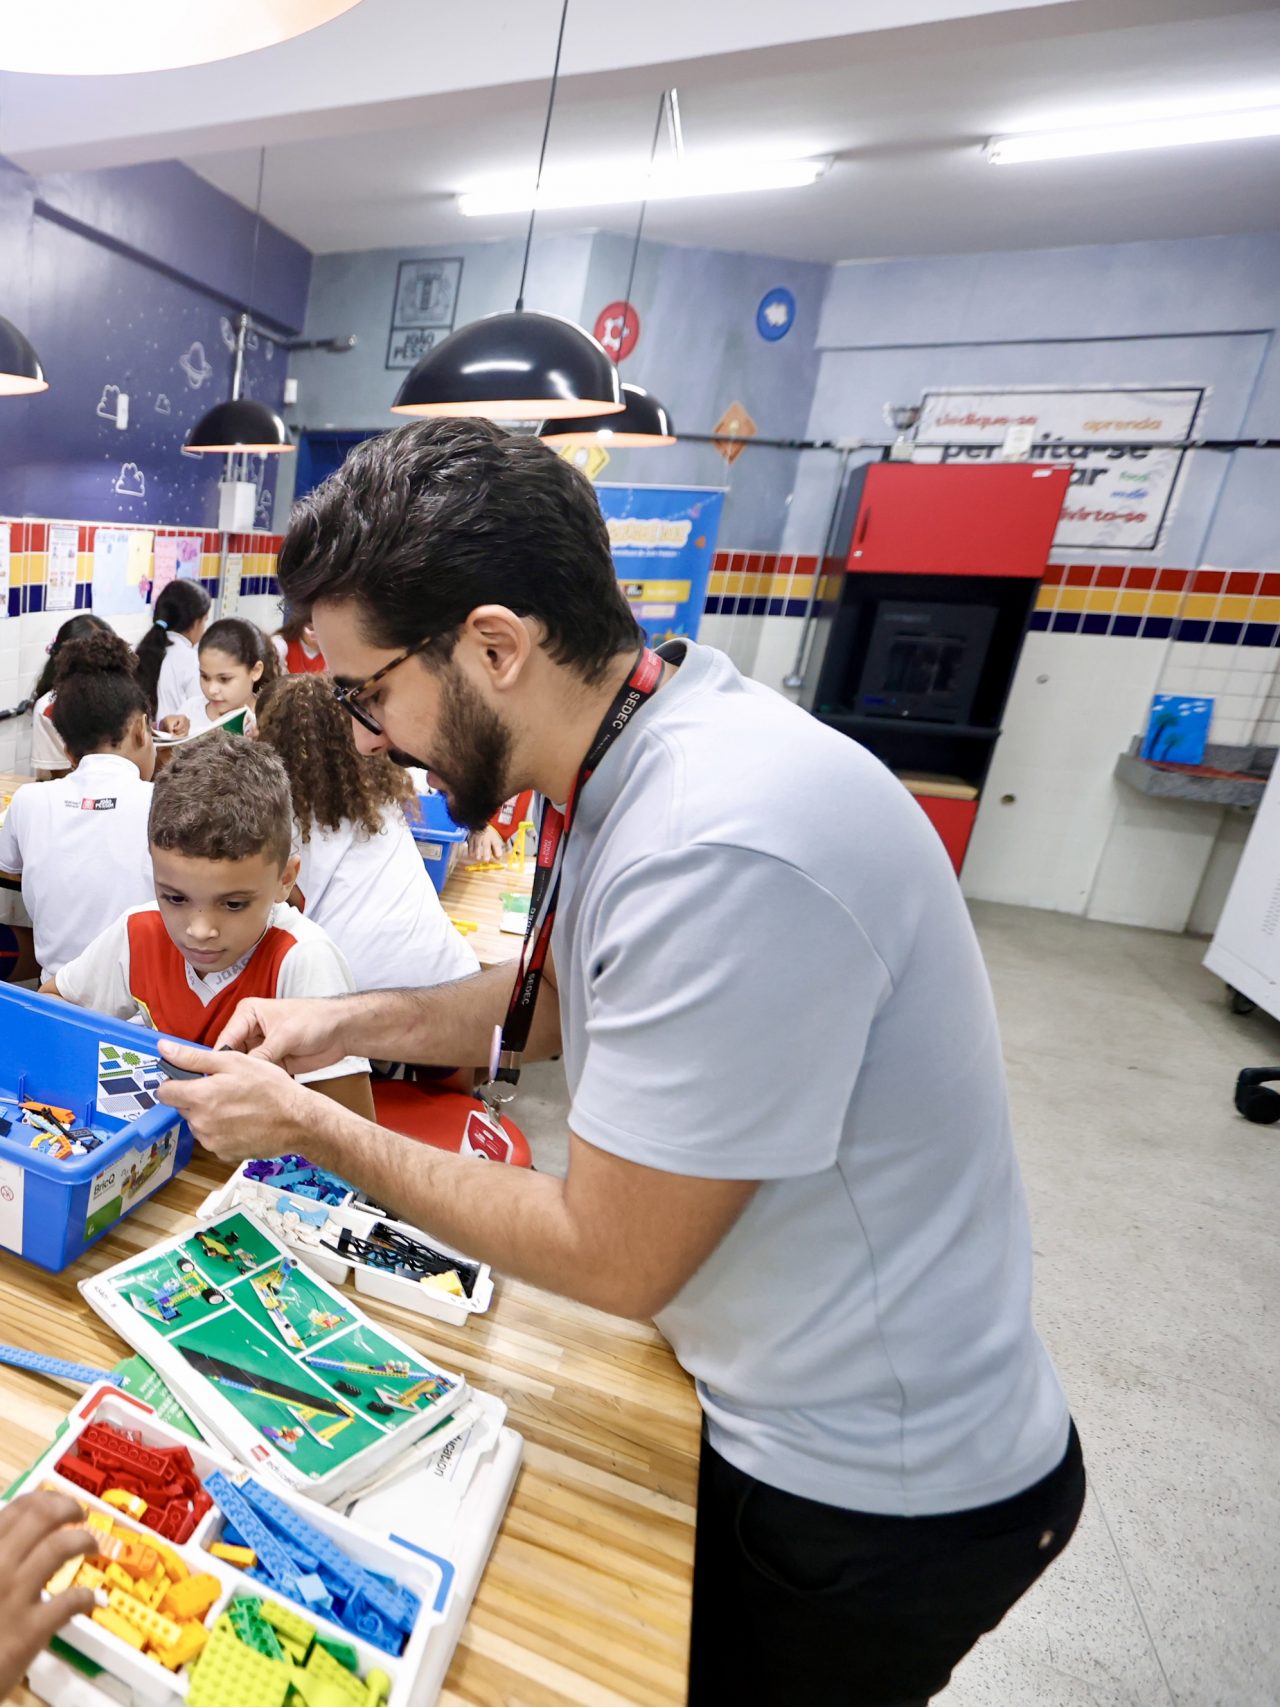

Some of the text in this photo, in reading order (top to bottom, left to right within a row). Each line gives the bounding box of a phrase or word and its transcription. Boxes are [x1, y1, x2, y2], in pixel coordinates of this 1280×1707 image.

[1082, 417, 1162, 432] aprenda
[940, 432, 1150, 463] perita-se
[613, 691, 641, 730] SEDEC
[94, 1173, 115, 1196] BricQ
